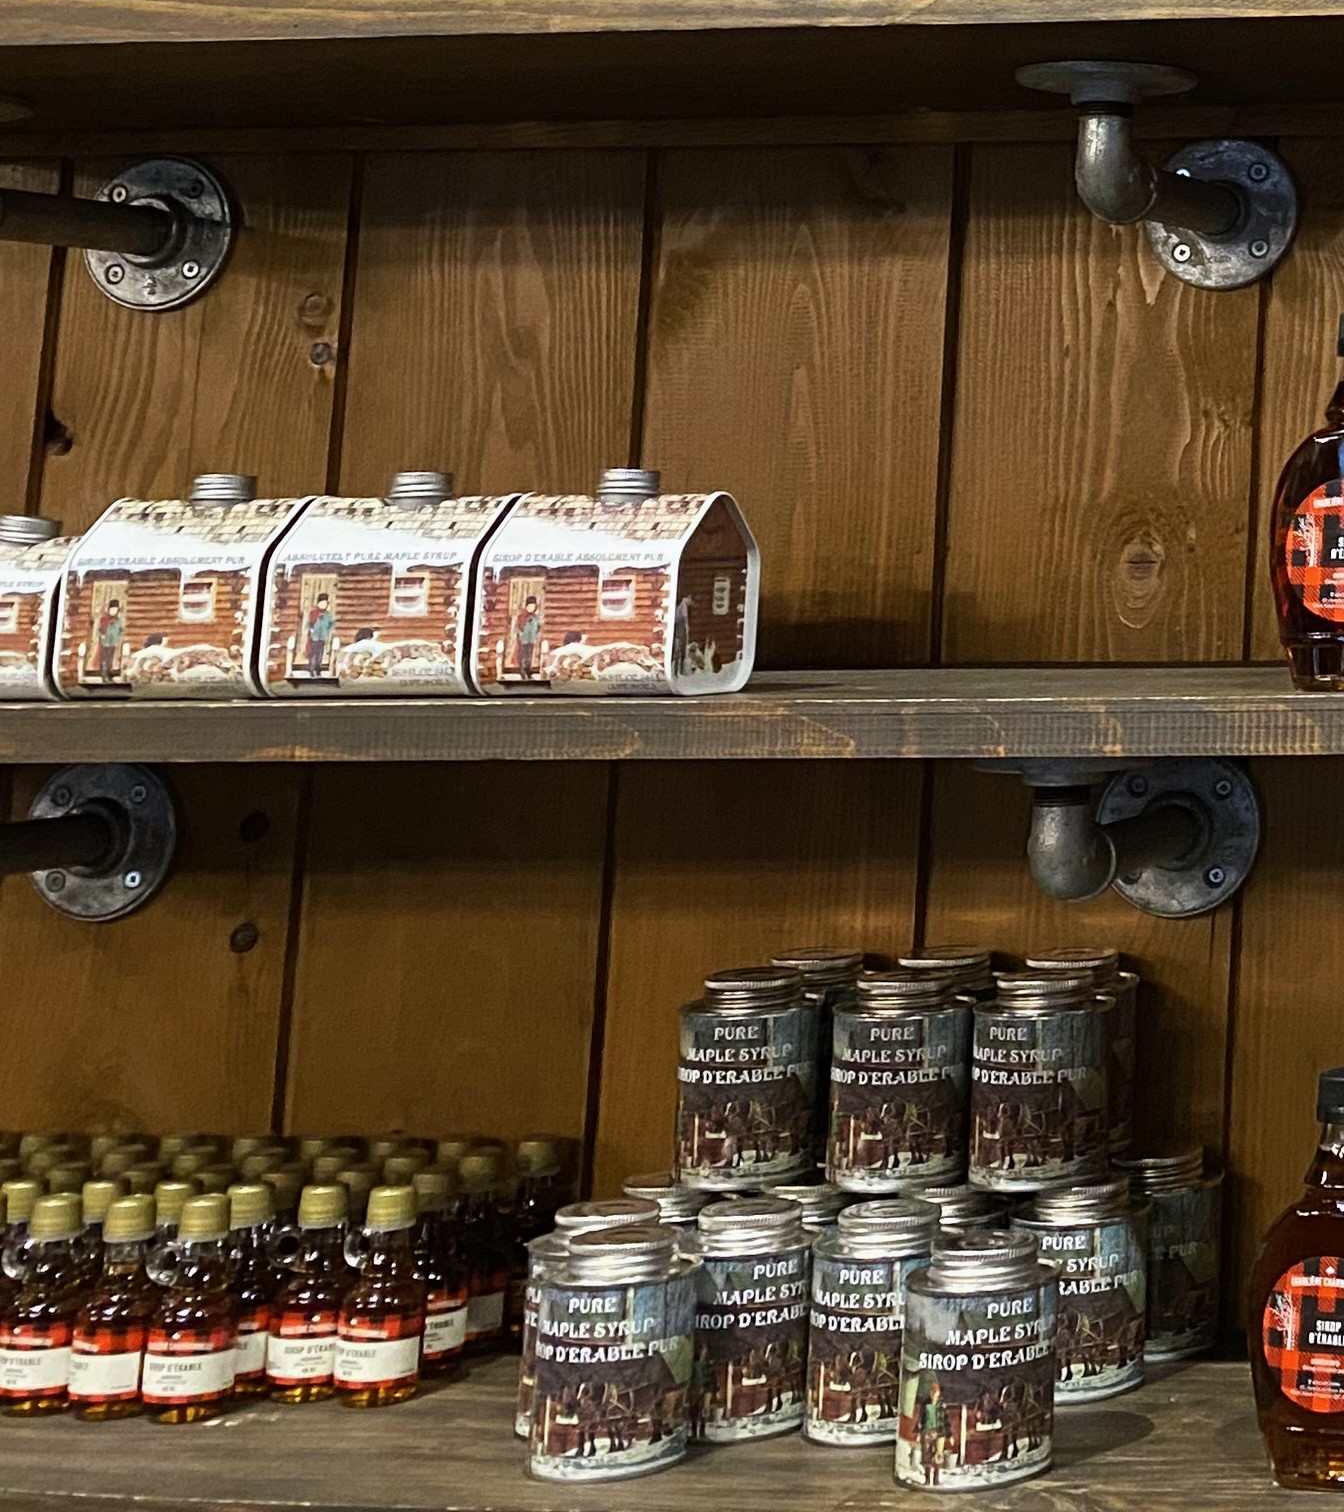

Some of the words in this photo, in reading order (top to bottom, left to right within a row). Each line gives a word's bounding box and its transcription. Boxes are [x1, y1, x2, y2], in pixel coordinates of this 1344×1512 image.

[714, 1026, 759, 1041] PURE
[870, 1026, 915, 1042] PURE
[990, 1026, 1027, 1041] PURE
[738, 1043, 792, 1062] SYRUP
[894, 1044, 946, 1063] SYRUP
[1010, 1047, 1063, 1064] SYRUP
[703, 1068, 786, 1085] D'ERABLE
[859, 1068, 940, 1085] D'ERABLE
[981, 1067, 1053, 1086] D'ERABLE
[1057, 1067, 1087, 1084] PUR
[1041, 1236, 1087, 1252] PURE
[753, 1259, 798, 1281] PURE
[1066, 1253, 1120, 1273] SYRUP
[839, 1269, 884, 1285] PURE
[1114, 1269, 1138, 1289] PUR
[568, 1297, 617, 1315] PURE
[713, 1286, 776, 1307] MAPLE
[986, 1297, 1033, 1320] PURE
[593, 1317, 654, 1339] SYRUP
[945, 1326, 1011, 1346] MAPLE
[1316, 1320, 1342, 1333] SIROP
[556, 1341, 644, 1365] D'ERABLE
[647, 1335, 678, 1357] PUR
[919, 1351, 969, 1371] SIROP
[972, 1342, 1049, 1371] D'ERABLE
